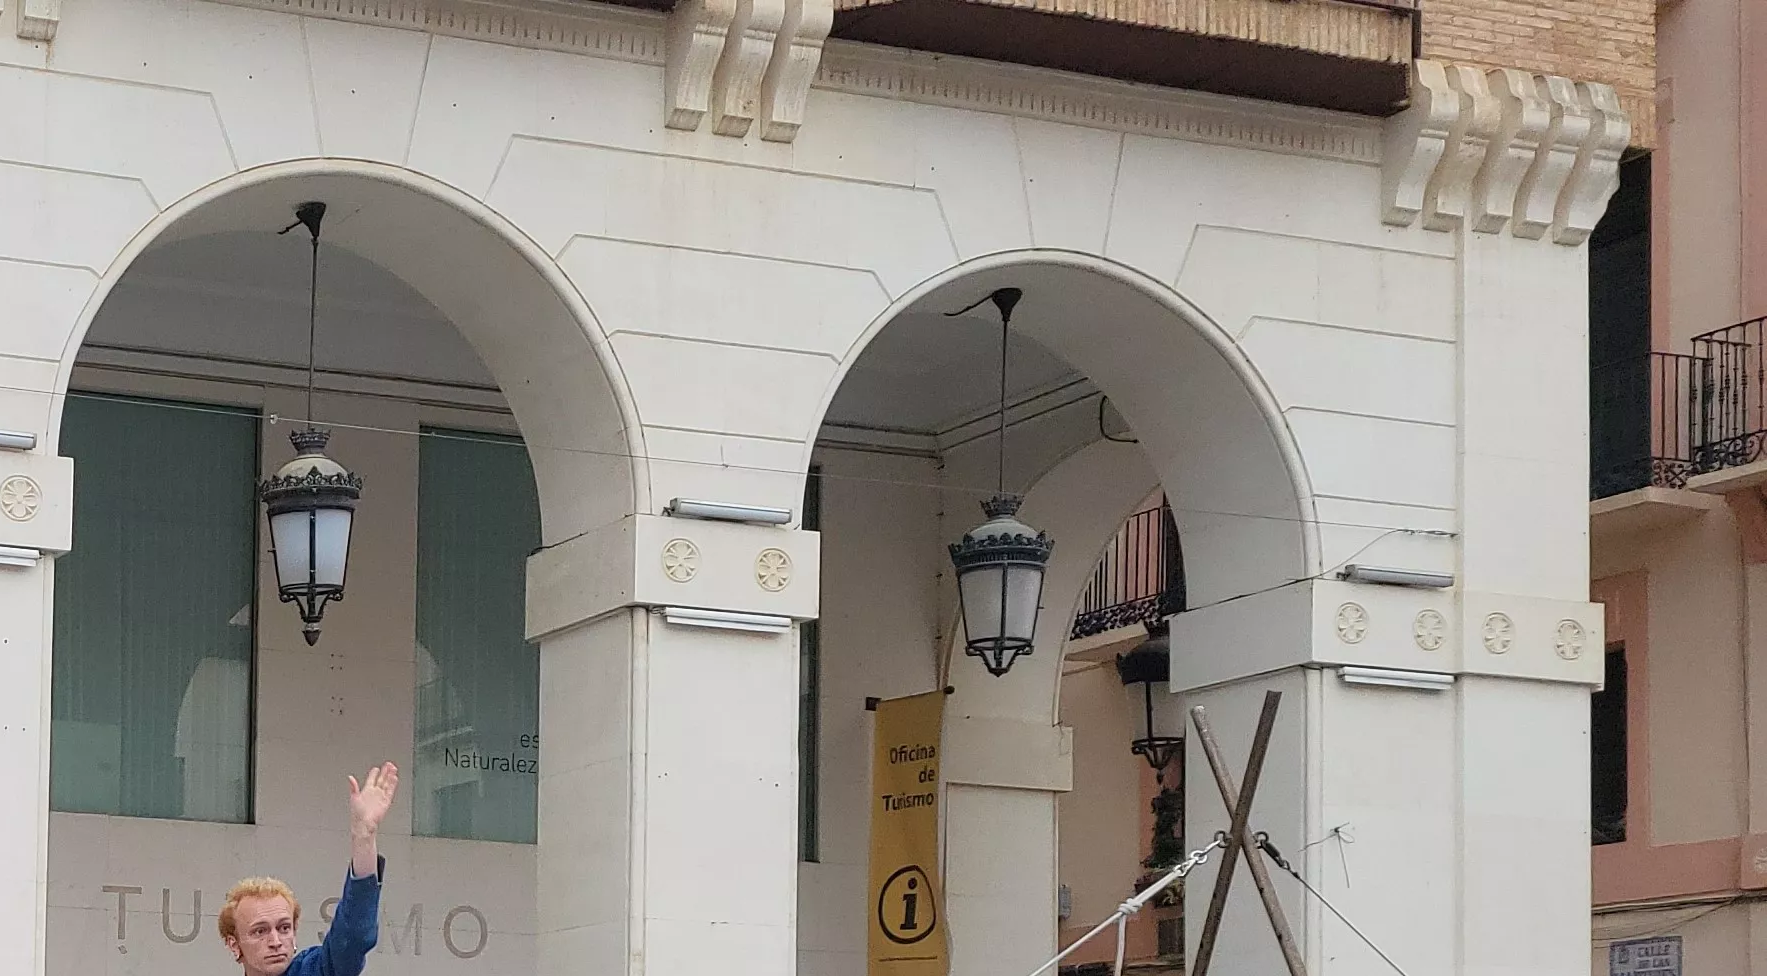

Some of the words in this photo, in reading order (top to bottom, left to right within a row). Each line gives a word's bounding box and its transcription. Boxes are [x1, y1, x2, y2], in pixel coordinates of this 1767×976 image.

[889, 744, 936, 764] Oficina
[918, 765, 935, 783] de
[882, 792, 935, 812] Turismo
[101, 885, 488, 959] TUSMO
